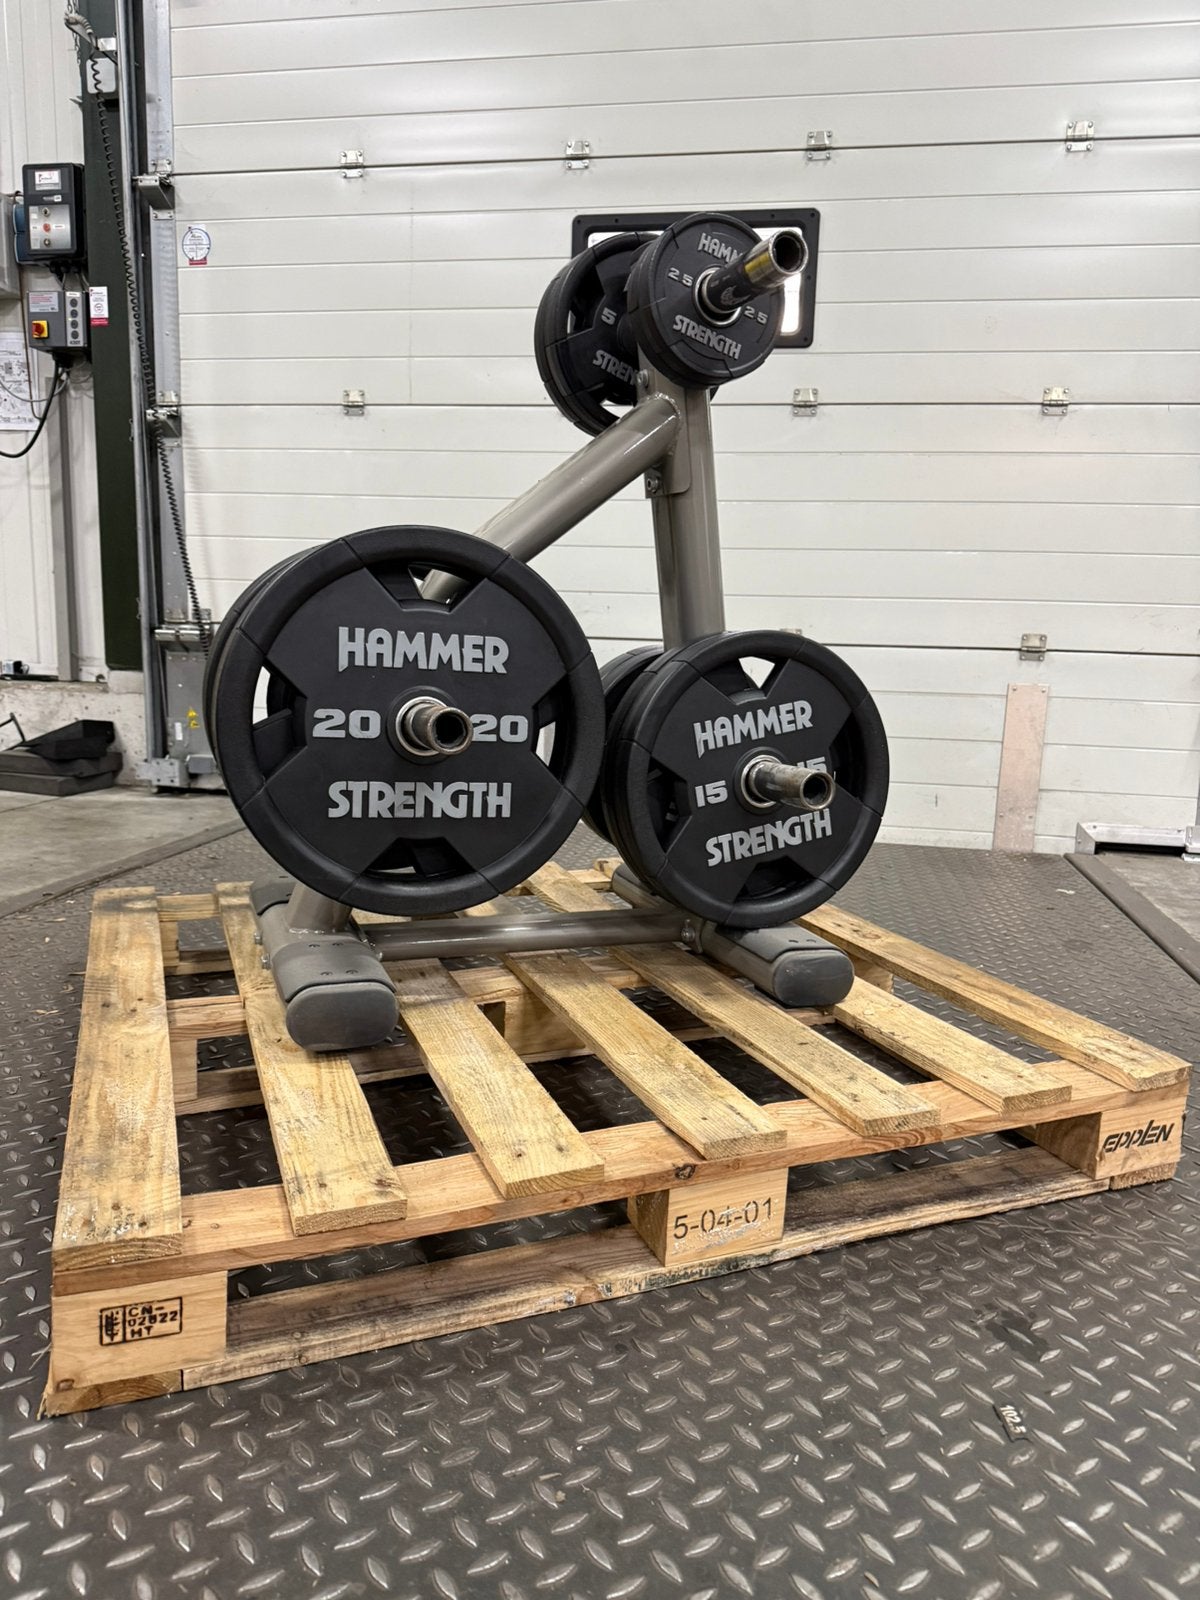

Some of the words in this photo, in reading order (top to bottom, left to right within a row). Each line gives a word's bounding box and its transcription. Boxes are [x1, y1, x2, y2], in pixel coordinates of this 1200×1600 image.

[601, 307, 617, 325] 5
[673, 314, 742, 359] STRENGTH
[592, 350, 637, 385] STREN
[338, 626, 509, 674] HAMMER
[312, 708, 381, 739] 20
[470, 714, 529, 743] 20
[693, 700, 813, 758] HAMMER
[328, 781, 512, 819] STRENGTH
[694, 780, 728, 807] 15
[705, 808, 832, 867] STRENGTH
[673, 1197, 773, 1240] 5-04-01
[130, 1325, 154, 1338] HT
